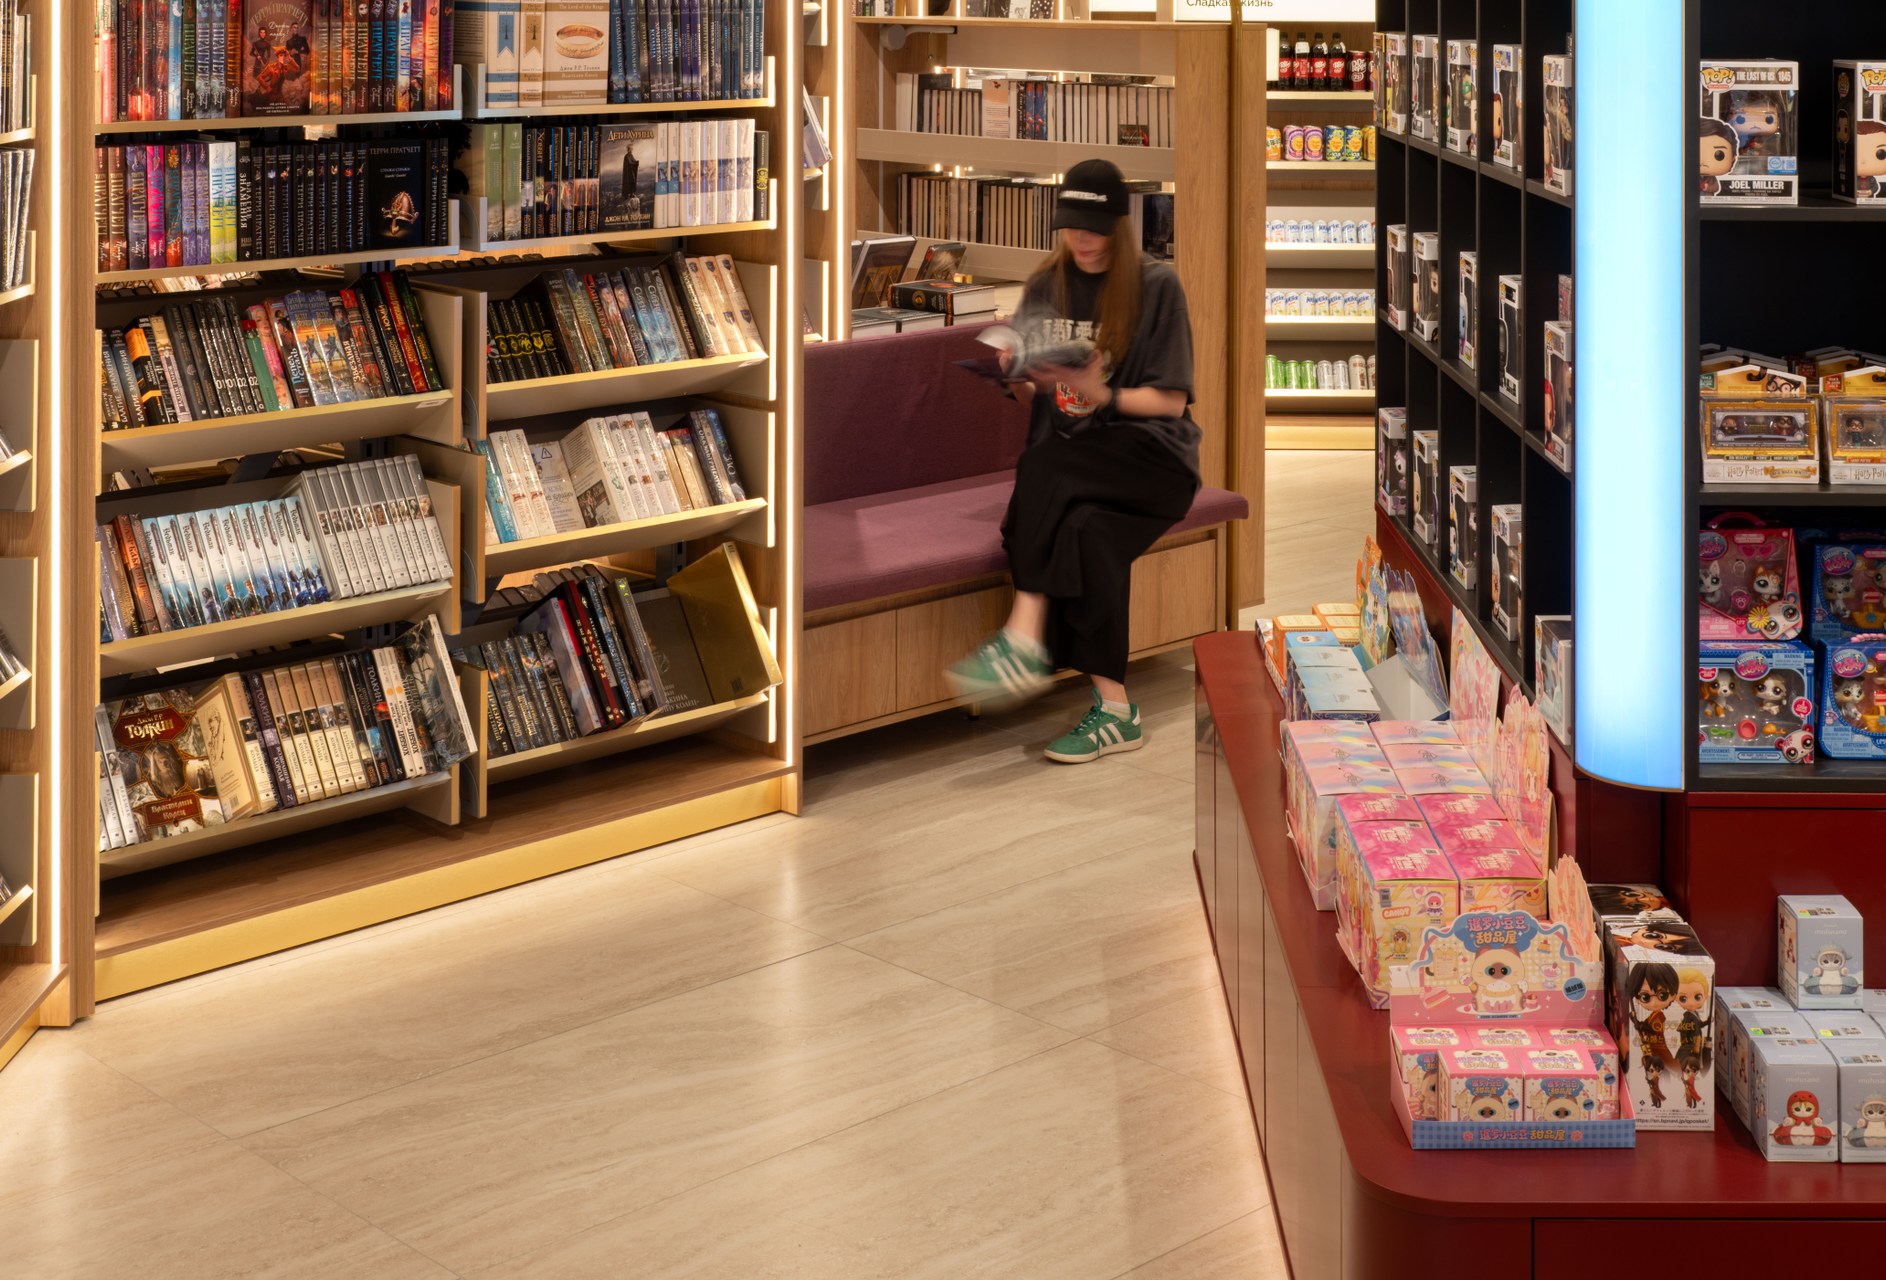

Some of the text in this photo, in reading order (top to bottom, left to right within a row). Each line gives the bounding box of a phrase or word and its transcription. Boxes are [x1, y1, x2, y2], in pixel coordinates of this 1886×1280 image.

[1701, 68, 1735, 85] POP!
[1736, 71, 1746, 81] THE
[1747, 71, 1759, 81] LAST
[370, 145, 421, 156] ТЕРРИ ПРАТЧЕТТ
[1729, 180, 1784, 189] JOEL MILLER
[239, 172, 247, 229] ЗНАМЕНИЯ
[367, 665, 383, 707] ТОЛКИН
[1382, 907, 1411, 918] CANDY
[1475, 931, 1517, 945] 甜品屋
[1529, 1129, 1566, 1141] 甜品屋
